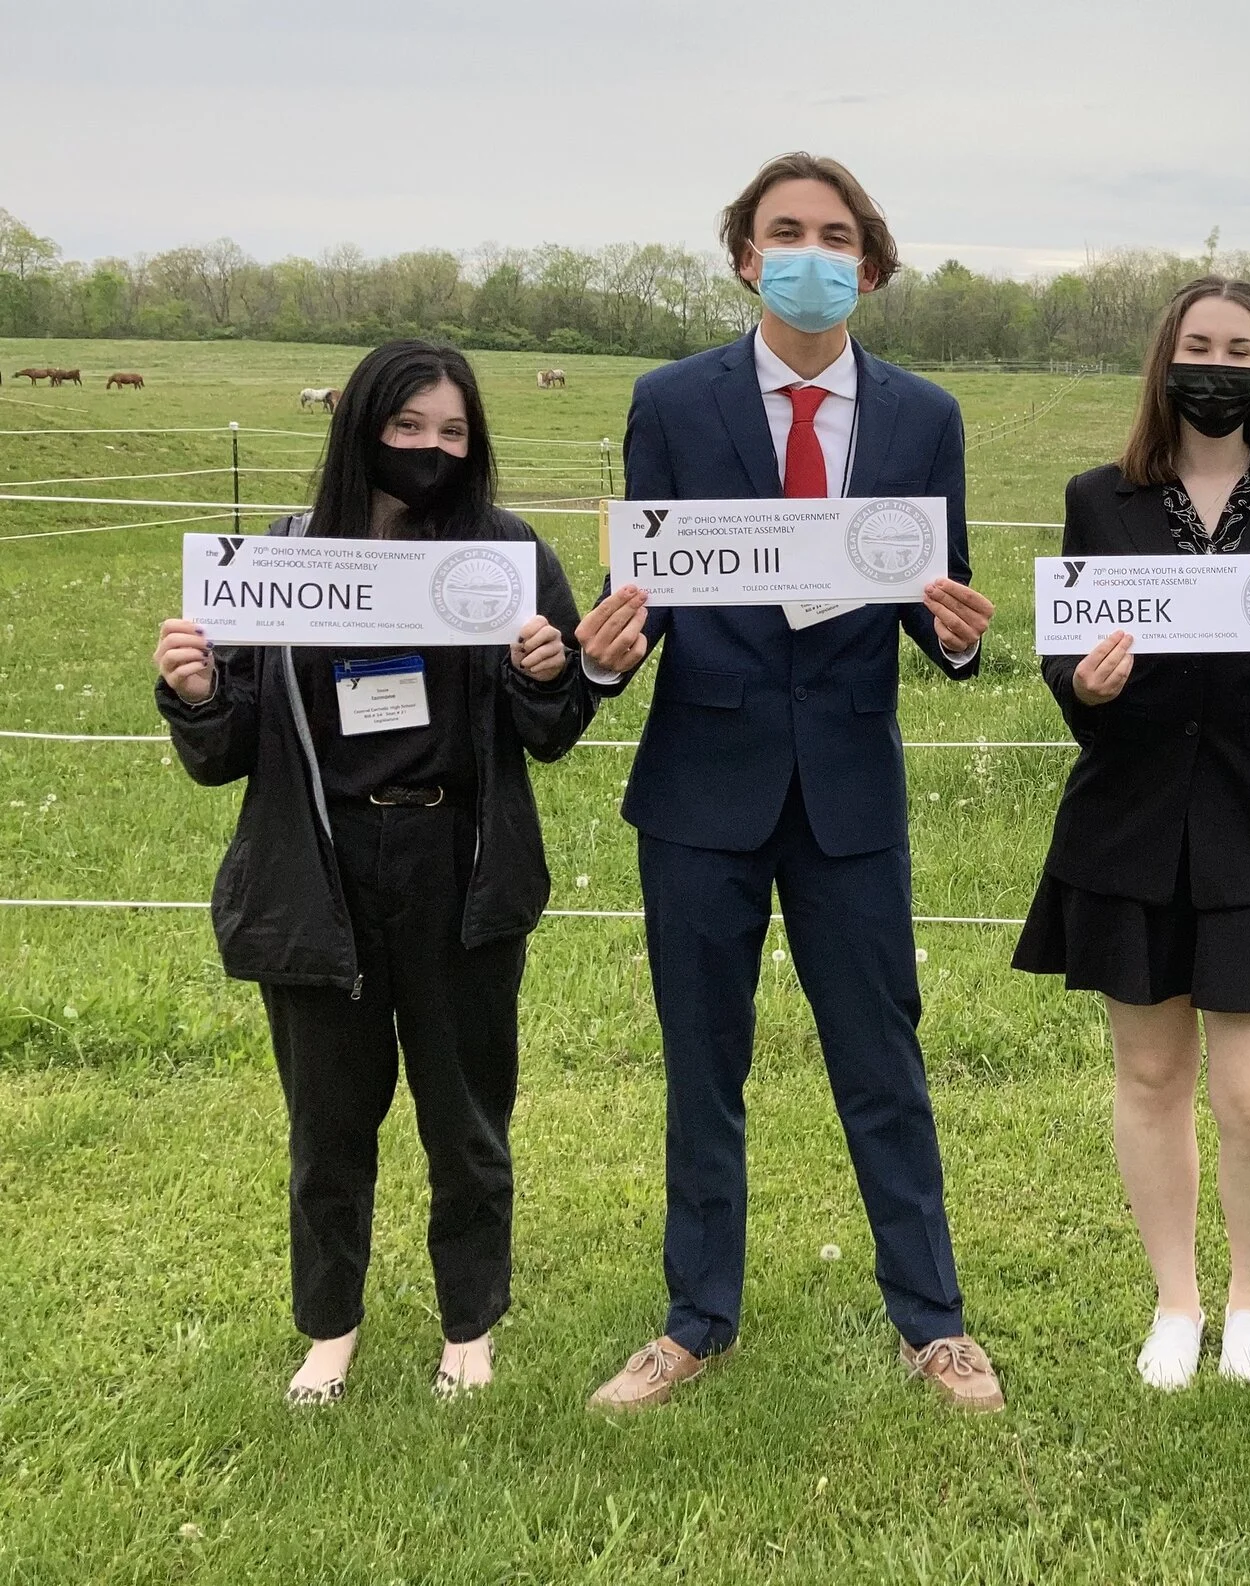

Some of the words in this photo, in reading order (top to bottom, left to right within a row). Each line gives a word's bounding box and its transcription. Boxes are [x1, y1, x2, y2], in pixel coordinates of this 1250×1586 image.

[695, 516, 716, 524] OHIO
[718, 515, 742, 523] YMCA
[744, 514, 771, 522] YOUTH
[783, 512, 840, 521] GOVERNMENT
[678, 528, 697, 536] HIGH
[698, 527, 728, 536] SCHOOL
[729, 527, 752, 535] STATE
[754, 526, 794, 534] ASSEMBLY
[295, 548, 321, 557] YMCA
[324, 549, 353, 558] YOUTH
[365, 551, 426, 560] GOVERNMENT
[274, 560, 306, 568] SCHOOL
[307, 561, 332, 569] STATE
[335, 562, 377, 571] ASSEMBLY
[632, 549, 740, 577] FLOYD
[753, 548, 780, 574] III
[1186, 566, 1237, 574] GOVERNMENT
[204, 580, 373, 610] IANNONE
[1053, 598, 1172, 624] DRABEK
